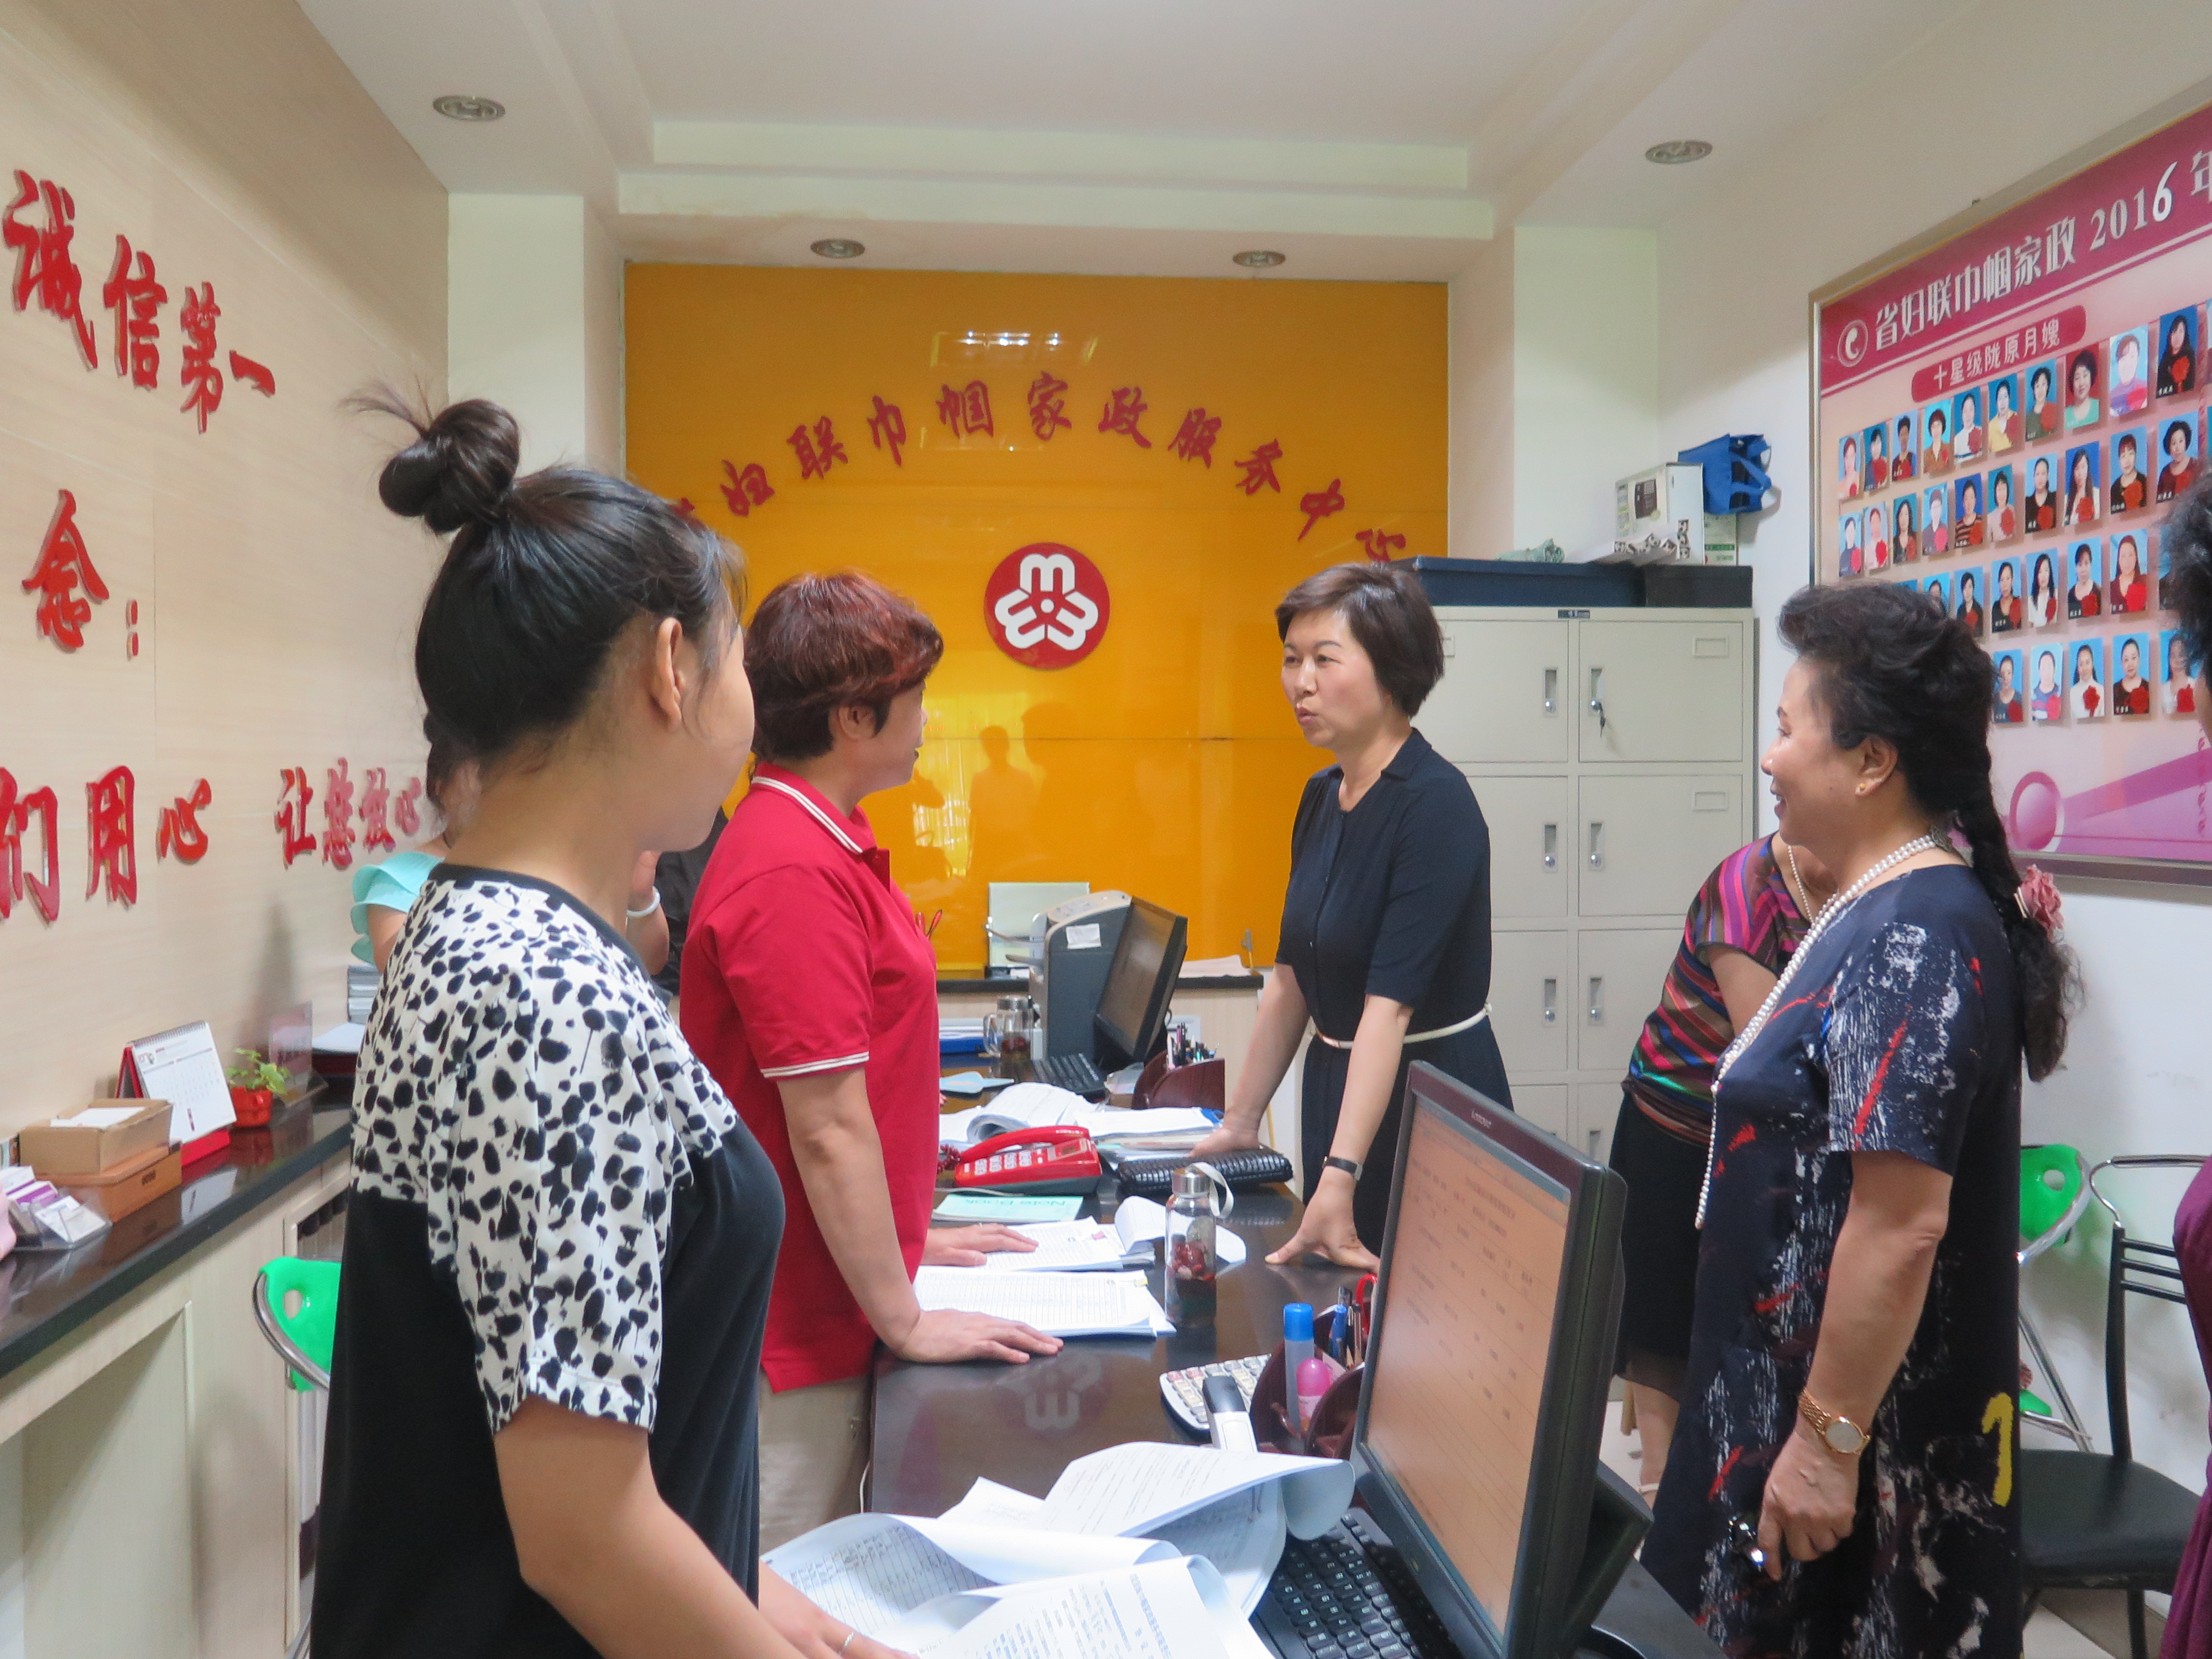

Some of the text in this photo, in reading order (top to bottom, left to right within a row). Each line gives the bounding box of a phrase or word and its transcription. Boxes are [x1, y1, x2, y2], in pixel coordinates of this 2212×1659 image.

[2, 169, 275, 434] 诚信第一
[1876, 215, 2076, 351] 省妇联巾帼家政
[2090, 161, 2178, 252] 2016
[1933, 319, 2060, 389] 十星级陇原月嫂
[669, 371, 1406, 562] 妇联巾帼家政服务中心
[275, 757, 421, 870] 让您放心
